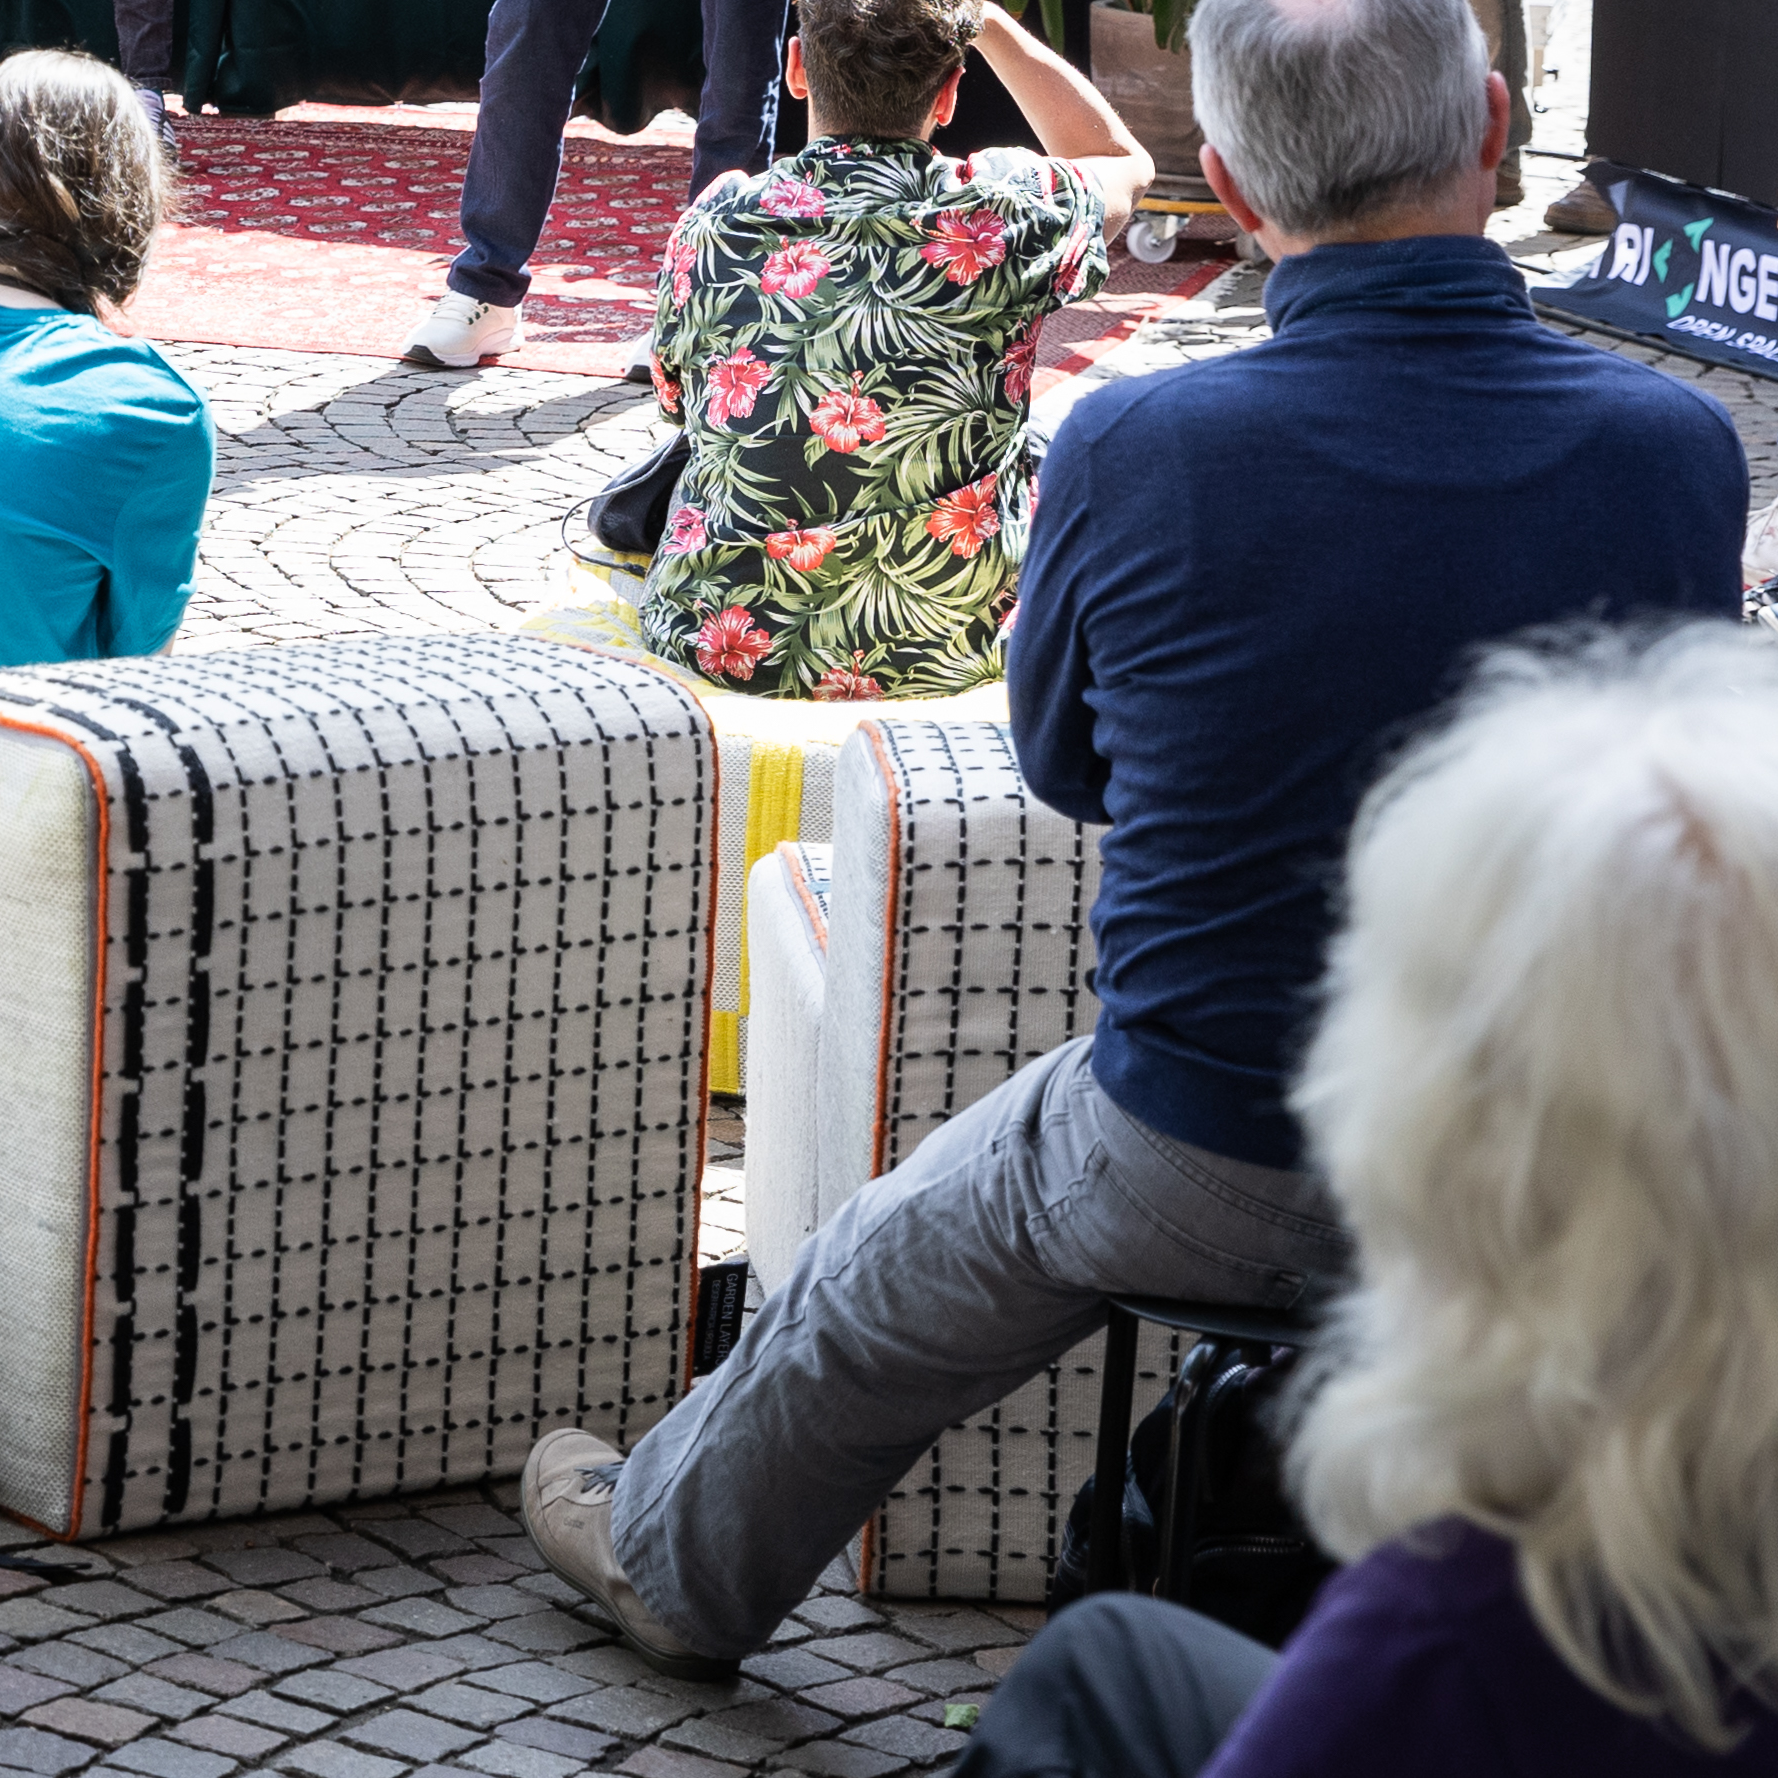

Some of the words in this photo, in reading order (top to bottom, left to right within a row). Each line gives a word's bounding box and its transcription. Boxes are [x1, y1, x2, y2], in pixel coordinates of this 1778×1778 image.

[1665, 314, 1738, 343] OPEN
[720, 1272, 739, 1320] GARDEN
[714, 1323, 732, 1367] LAYERS
